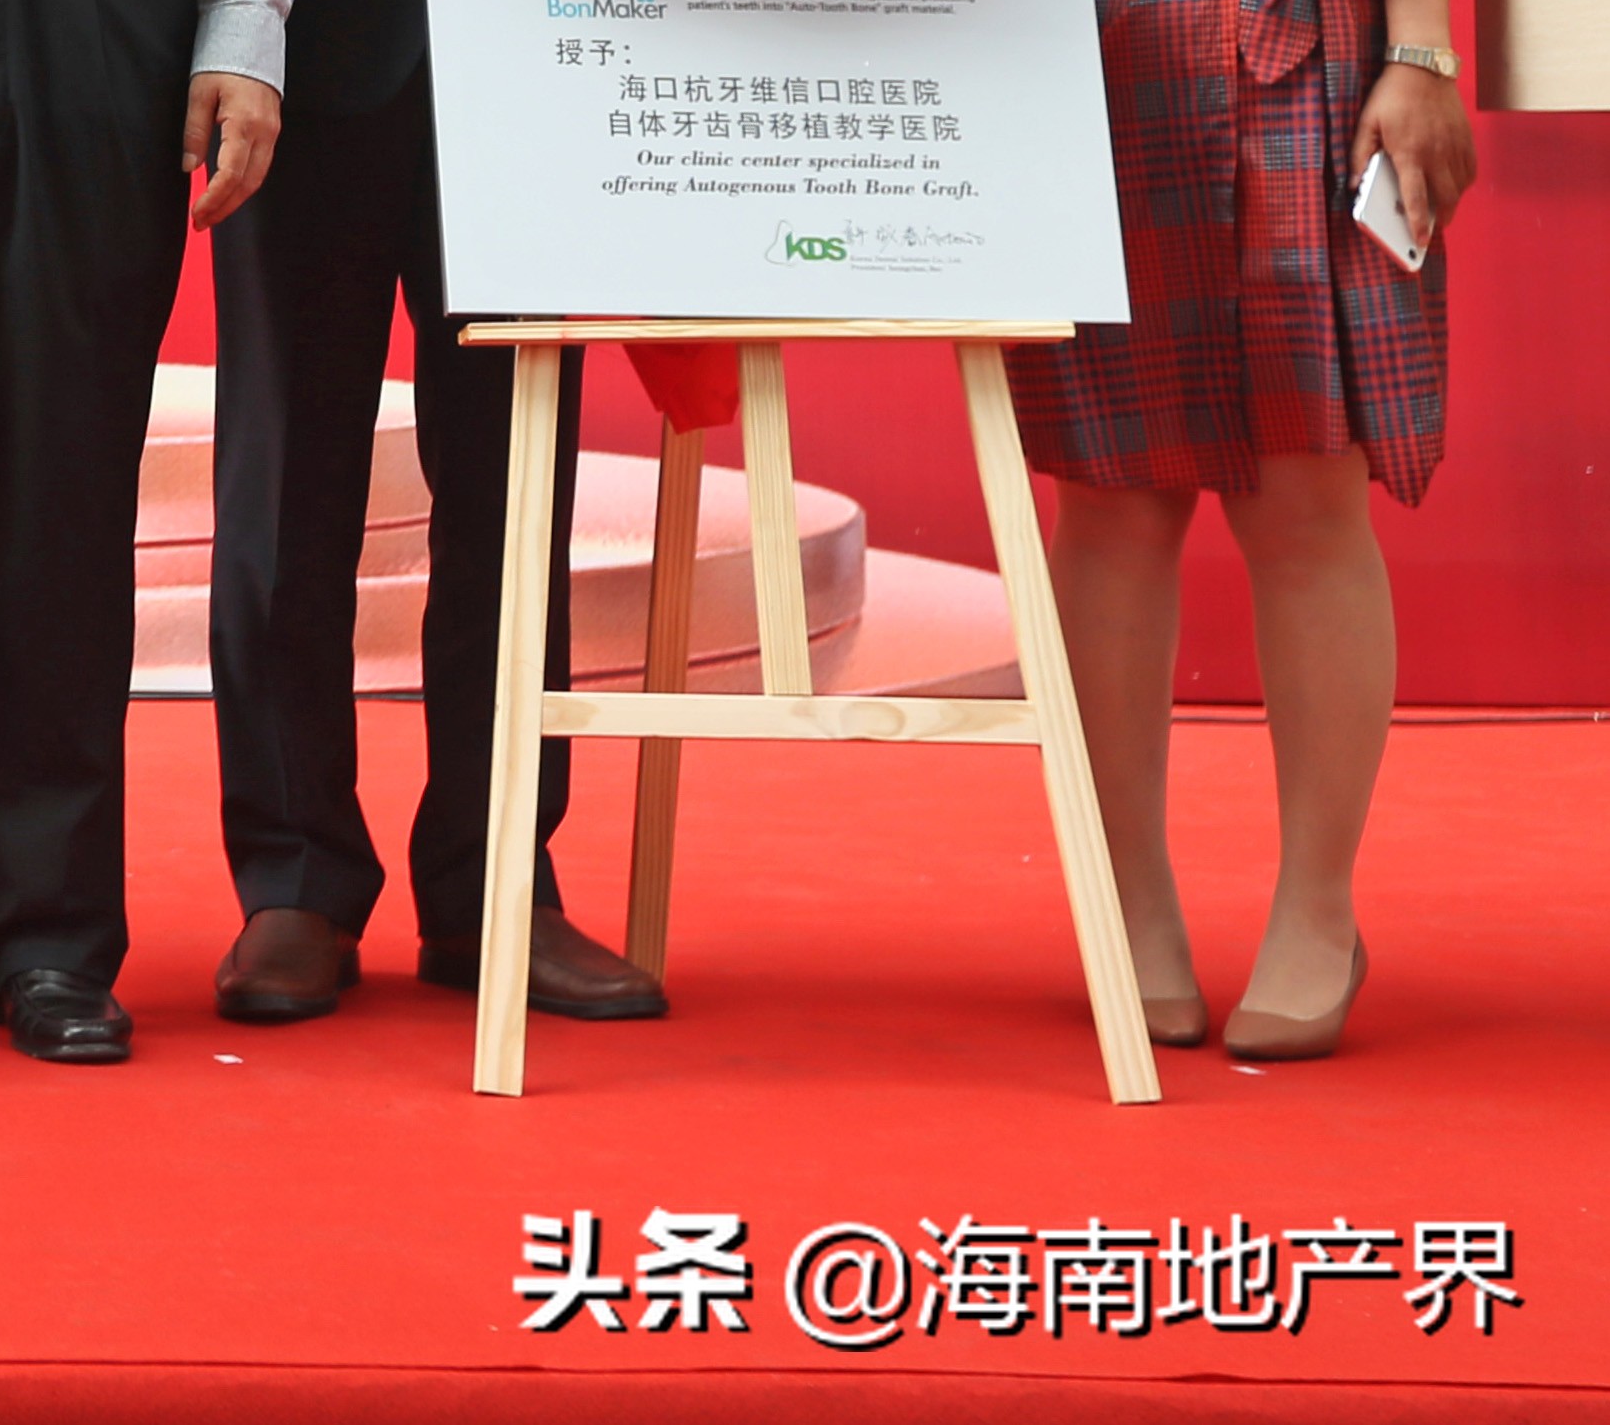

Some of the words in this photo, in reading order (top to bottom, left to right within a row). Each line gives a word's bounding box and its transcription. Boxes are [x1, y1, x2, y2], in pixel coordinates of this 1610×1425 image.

[619, 75, 942, 106] 海口杭牙维信口腔医院
[608, 110, 962, 142] 自体牙齿骨移植教学医院
[637, 150, 675, 167] Our
[682, 150, 733, 167] clinic
[741, 153, 802, 168] center
[808, 153, 914, 172] specialized
[922, 155, 940, 170] in
[602, 176, 678, 196] offering
[684, 178, 796, 196] Autogenous
[803, 179, 857, 195] Tooth
[865, 180, 915, 196] Bone
[923, 180, 979, 200] Graft.
[785, 231, 848, 261] KDS
